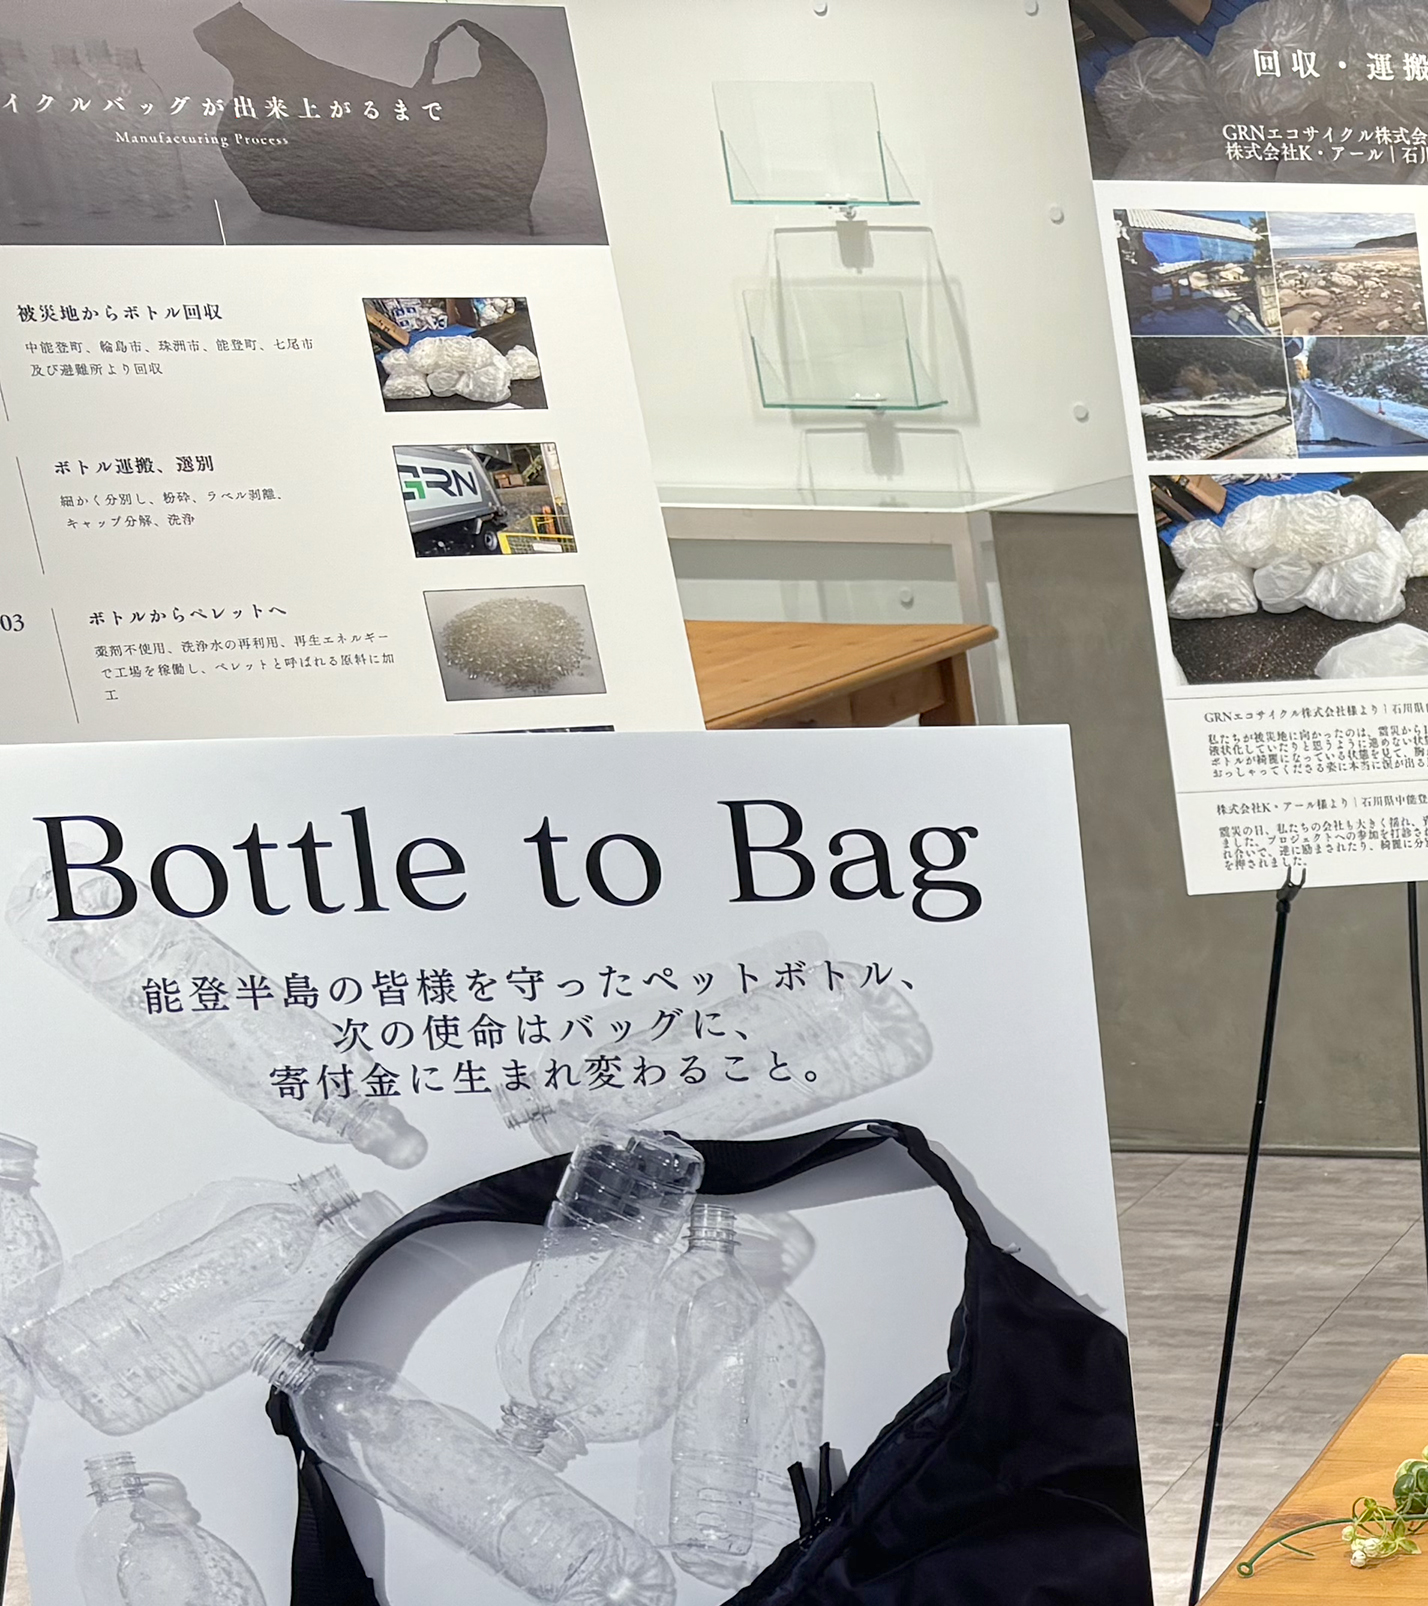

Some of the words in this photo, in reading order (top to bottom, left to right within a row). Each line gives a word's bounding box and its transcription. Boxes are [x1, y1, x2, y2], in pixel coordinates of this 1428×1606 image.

[4, 94, 442, 121] イクルバッグが出来上がるまで
[116, 131, 229, 149] Manufacturing
[235, 134, 288, 145] Process
[18, 304, 222, 322] 被災地からボトル回収
[31, 363, 163, 376] 及び避難所より回収
[55, 455, 213, 475] ボトル運搬、選別
[397, 465, 478, 501] GRN
[67, 513, 195, 529] キャップ分解、洗浄
[1, 615, 24, 631] 03
[90, 604, 286, 625] ボトルからペレットへ
[105, 690, 118, 700] 工
[34, 807, 467, 923] Bottle
[525, 814, 662, 910] to
[720, 798, 983, 925] Bag
[142, 961, 913, 1014] 能登半島の皆様を守ったペットボトル、
[332, 1008, 747, 1053] 次の使命はバッグに、
[270, 1051, 816, 1101] 寄付金に生まれ変わること。
